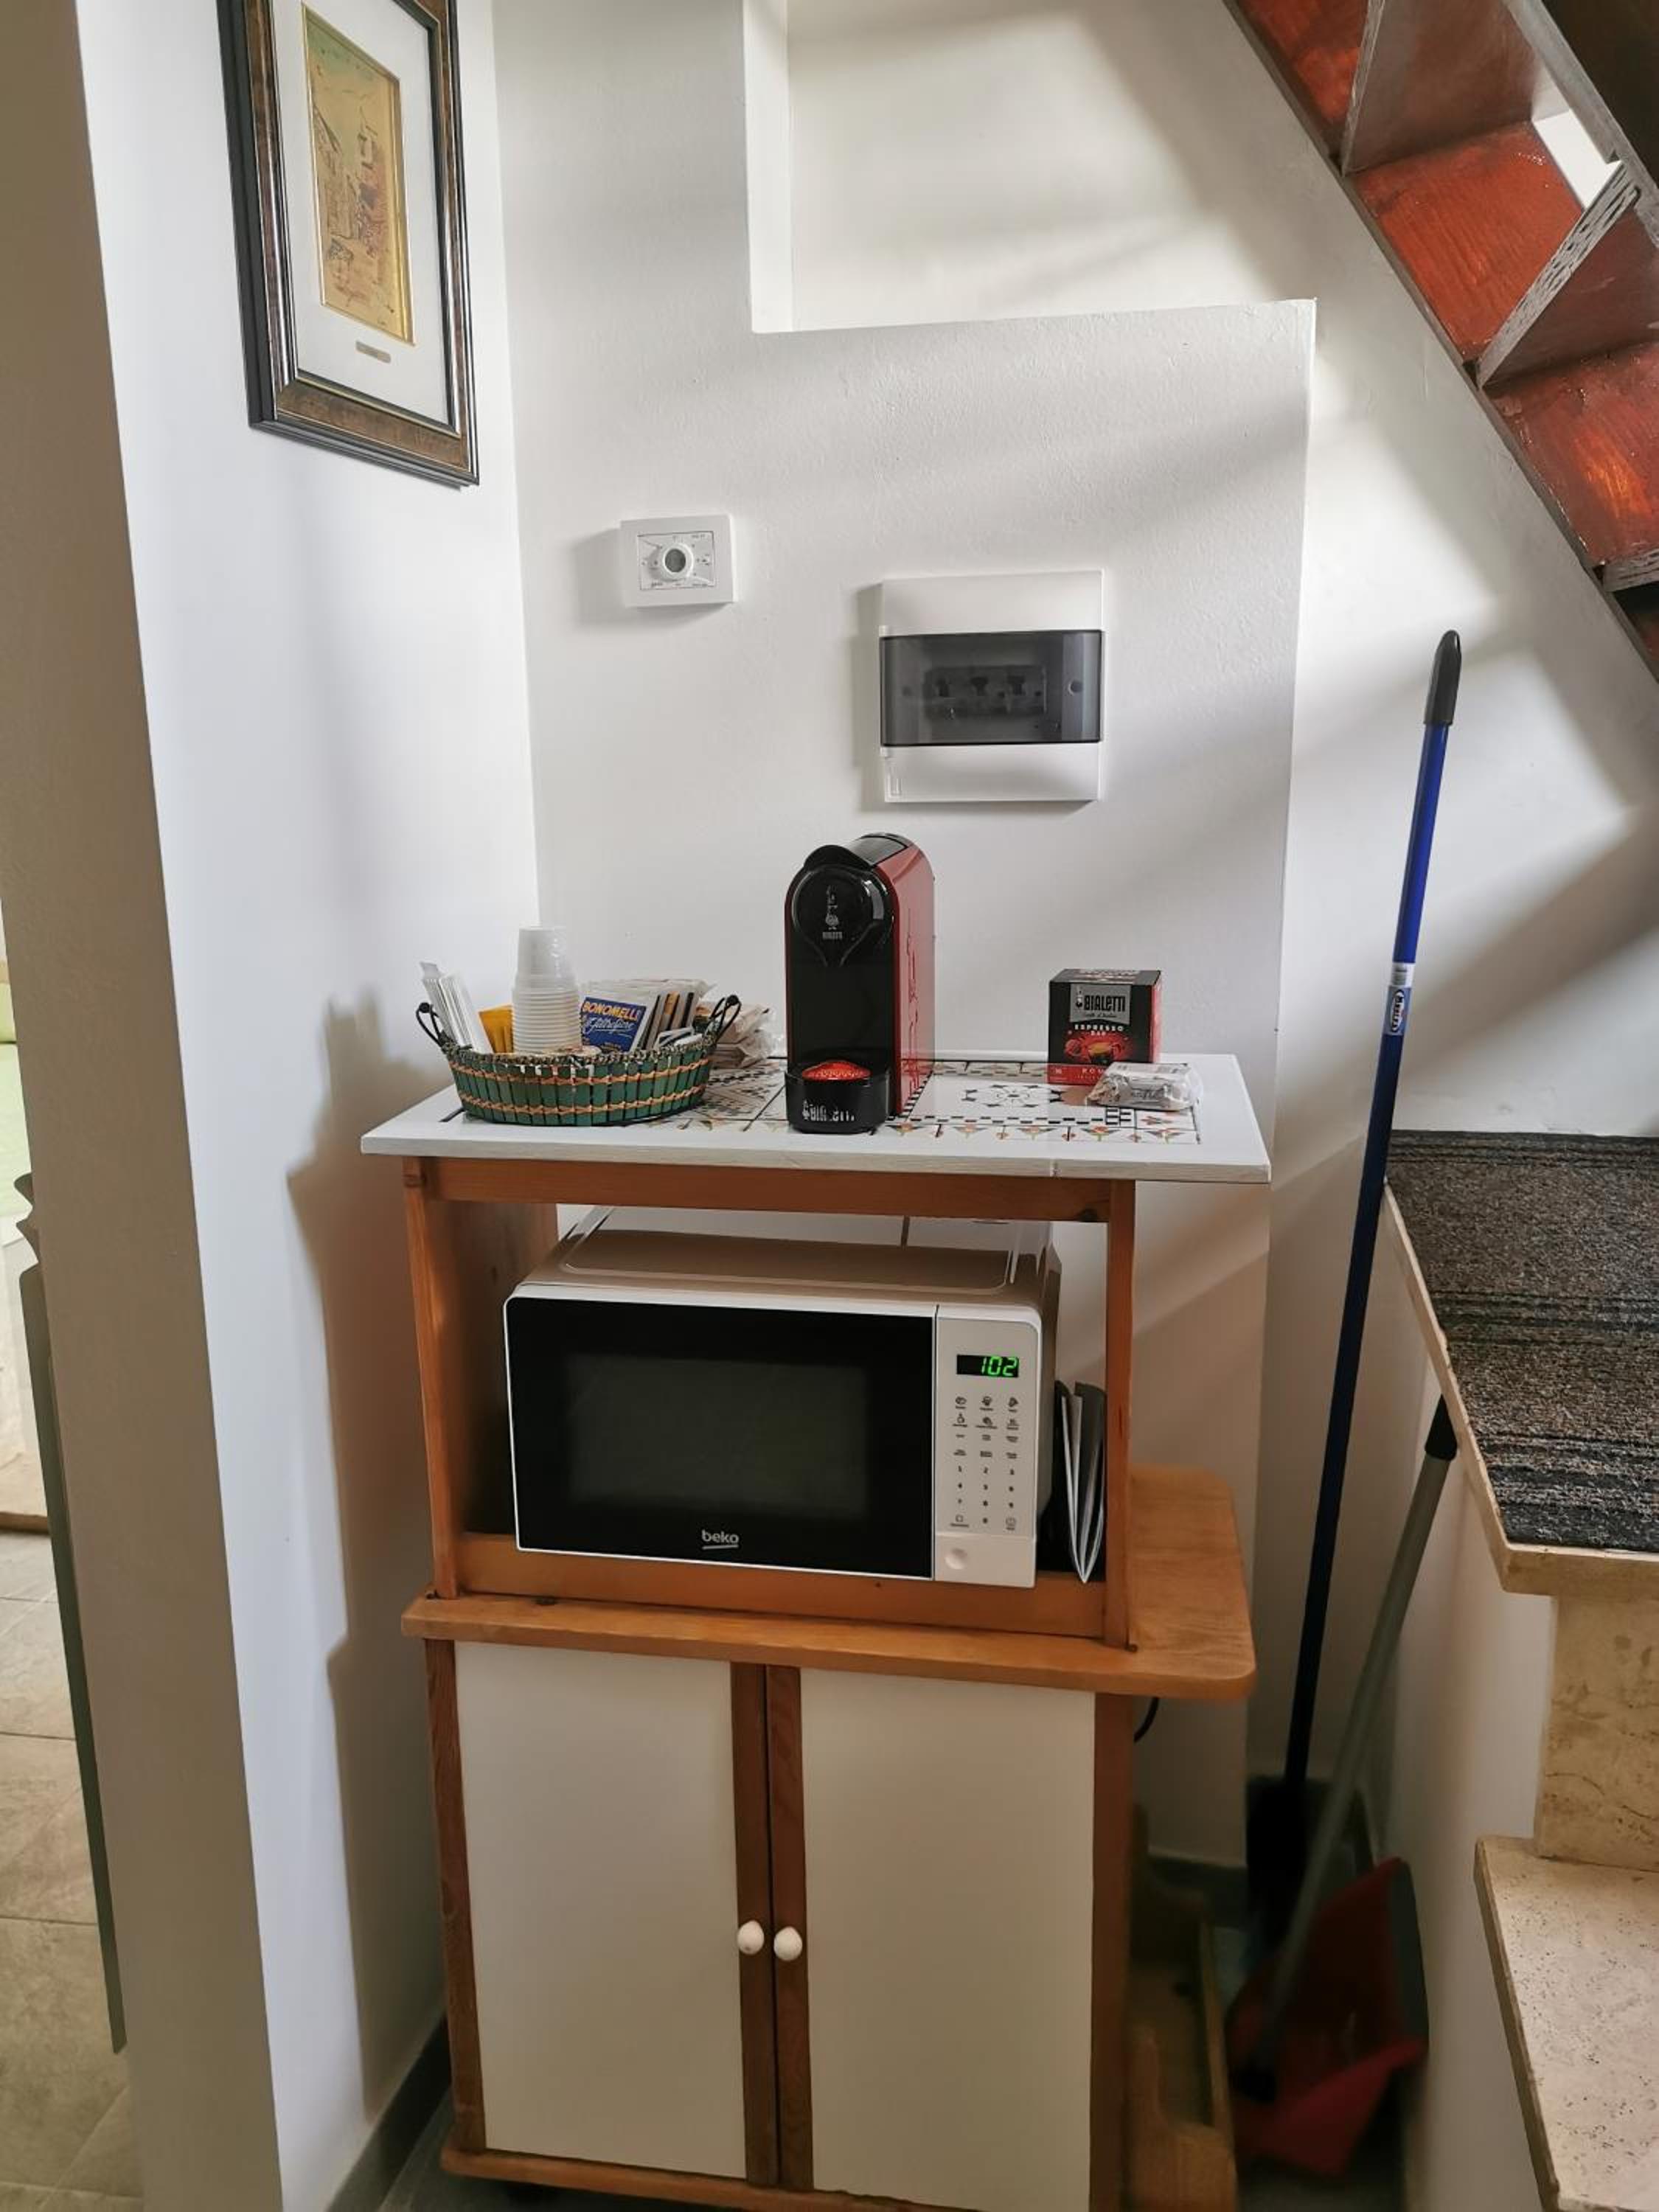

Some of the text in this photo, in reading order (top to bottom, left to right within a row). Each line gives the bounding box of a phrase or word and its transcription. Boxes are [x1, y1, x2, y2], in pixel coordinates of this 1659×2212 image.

[582, 1001, 641, 1022] BONOMELLI
[981, 1356, 1018, 1377] 102
[702, 1528, 740, 1543] beko
